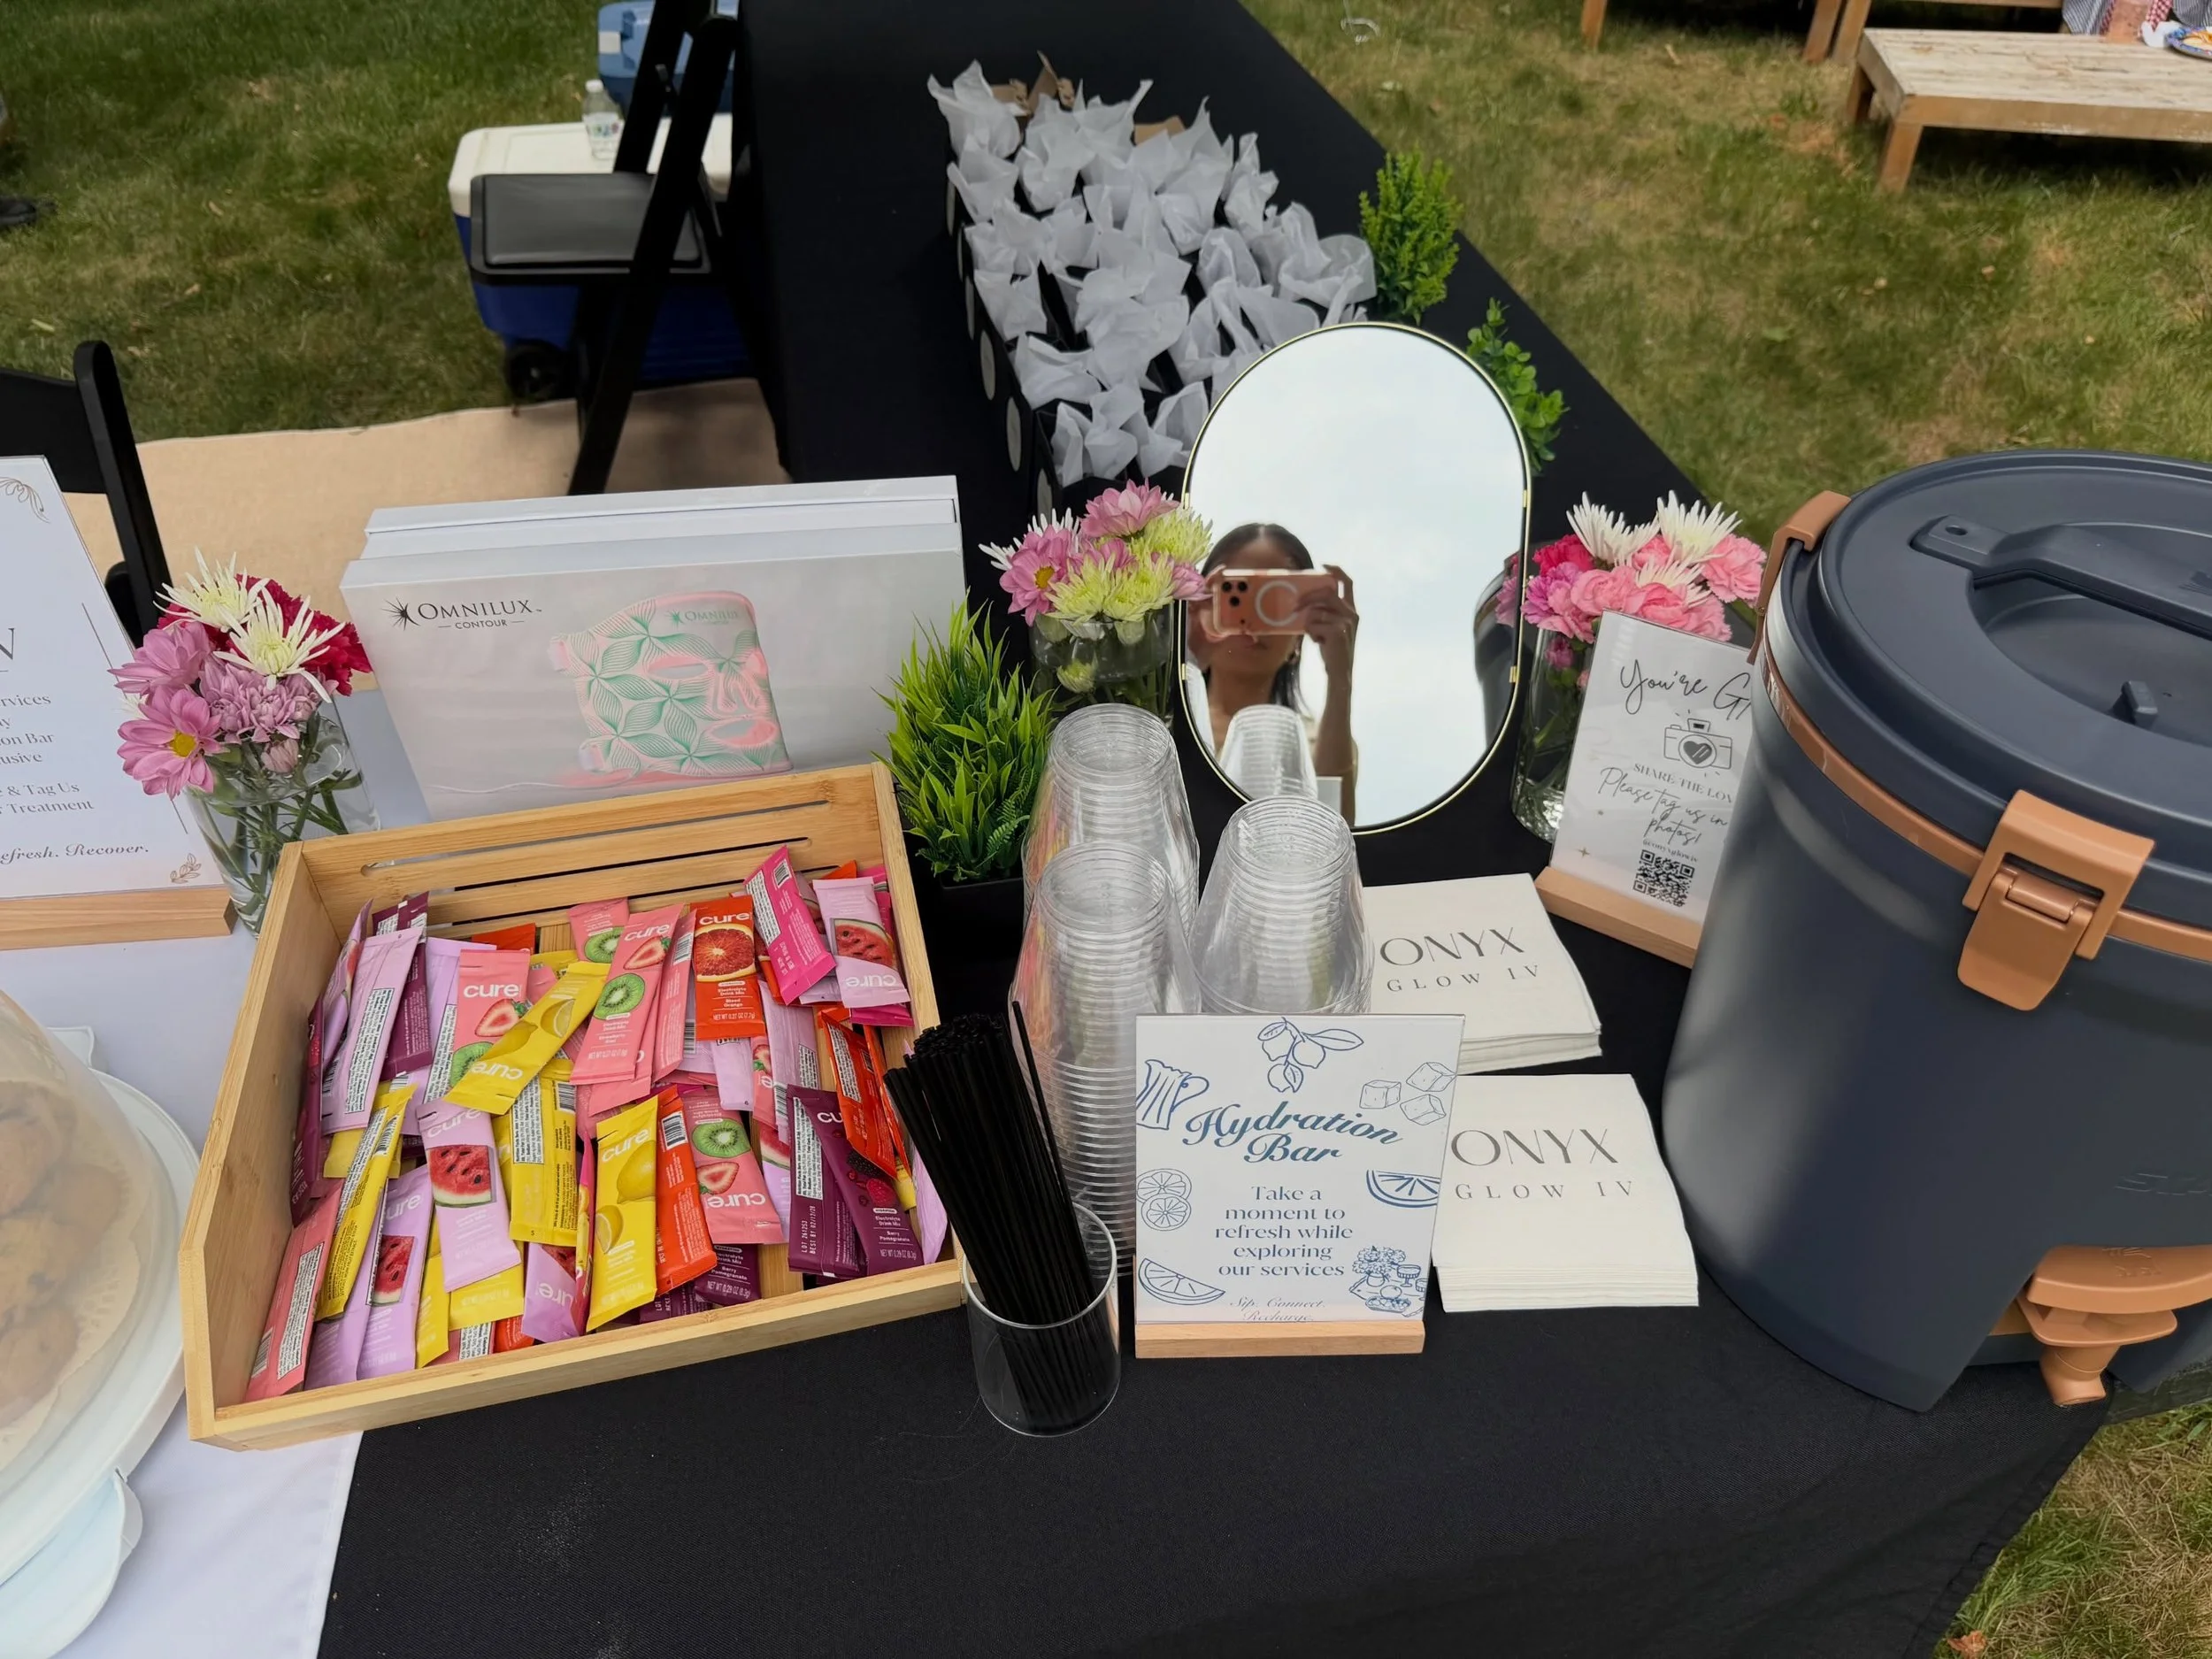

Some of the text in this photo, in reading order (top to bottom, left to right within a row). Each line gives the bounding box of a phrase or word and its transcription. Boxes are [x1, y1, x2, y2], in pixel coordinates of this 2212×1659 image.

[418, 599, 534, 619] OMNILUX
[455, 619, 508, 630] CONTOUR
[1620, 659, 1708, 714] You're
[0, 695, 51, 707] rvices
[25, 733, 54, 744] Bar
[0, 752, 43, 764] usive
[1633, 763, 1676, 784] SHARE
[1680, 778, 1704, 795] THE
[7, 785, 21, 796] &
[23, 784, 57, 796] Tag
[58, 782, 80, 793] Us
[1597, 766, 1653, 803] Please
[1710, 815, 1728, 826] in
[6, 800, 95, 814] Treatment
[65, 843, 149, 857] Recover.
[699, 912, 750, 926] cure
[625, 924, 670, 941] cure
[1379, 926, 1525, 966] ONYX
[845, 974, 897, 987] cure
[1386, 964, 1539, 992] GLOW IV
[464, 984, 520, 998] cure
[472, 1061, 523, 1080] cure
[427, 1109, 481, 1138] cure
[817, 1112, 843, 1124] cu
[1182, 1101, 1403, 1147] Hydration
[602, 1128, 649, 1163] cure
[1243, 1133, 1343, 1163] Bar
[1451, 1128, 1618, 1166] ONYX
[1250, 1186, 1322, 1201] Take a
[1455, 1180, 1632, 1200] GLOW IV
[386, 1194, 421, 1220] ure
[708, 1193, 766, 1209] cure
[1225, 1207, 1346, 1220] moment to
[1215, 1225, 1353, 1239] refresh while
[1233, 1244, 1332, 1261] exploring
[1218, 1263, 1345, 1276] our services
[539, 1283, 573, 1307] ure
